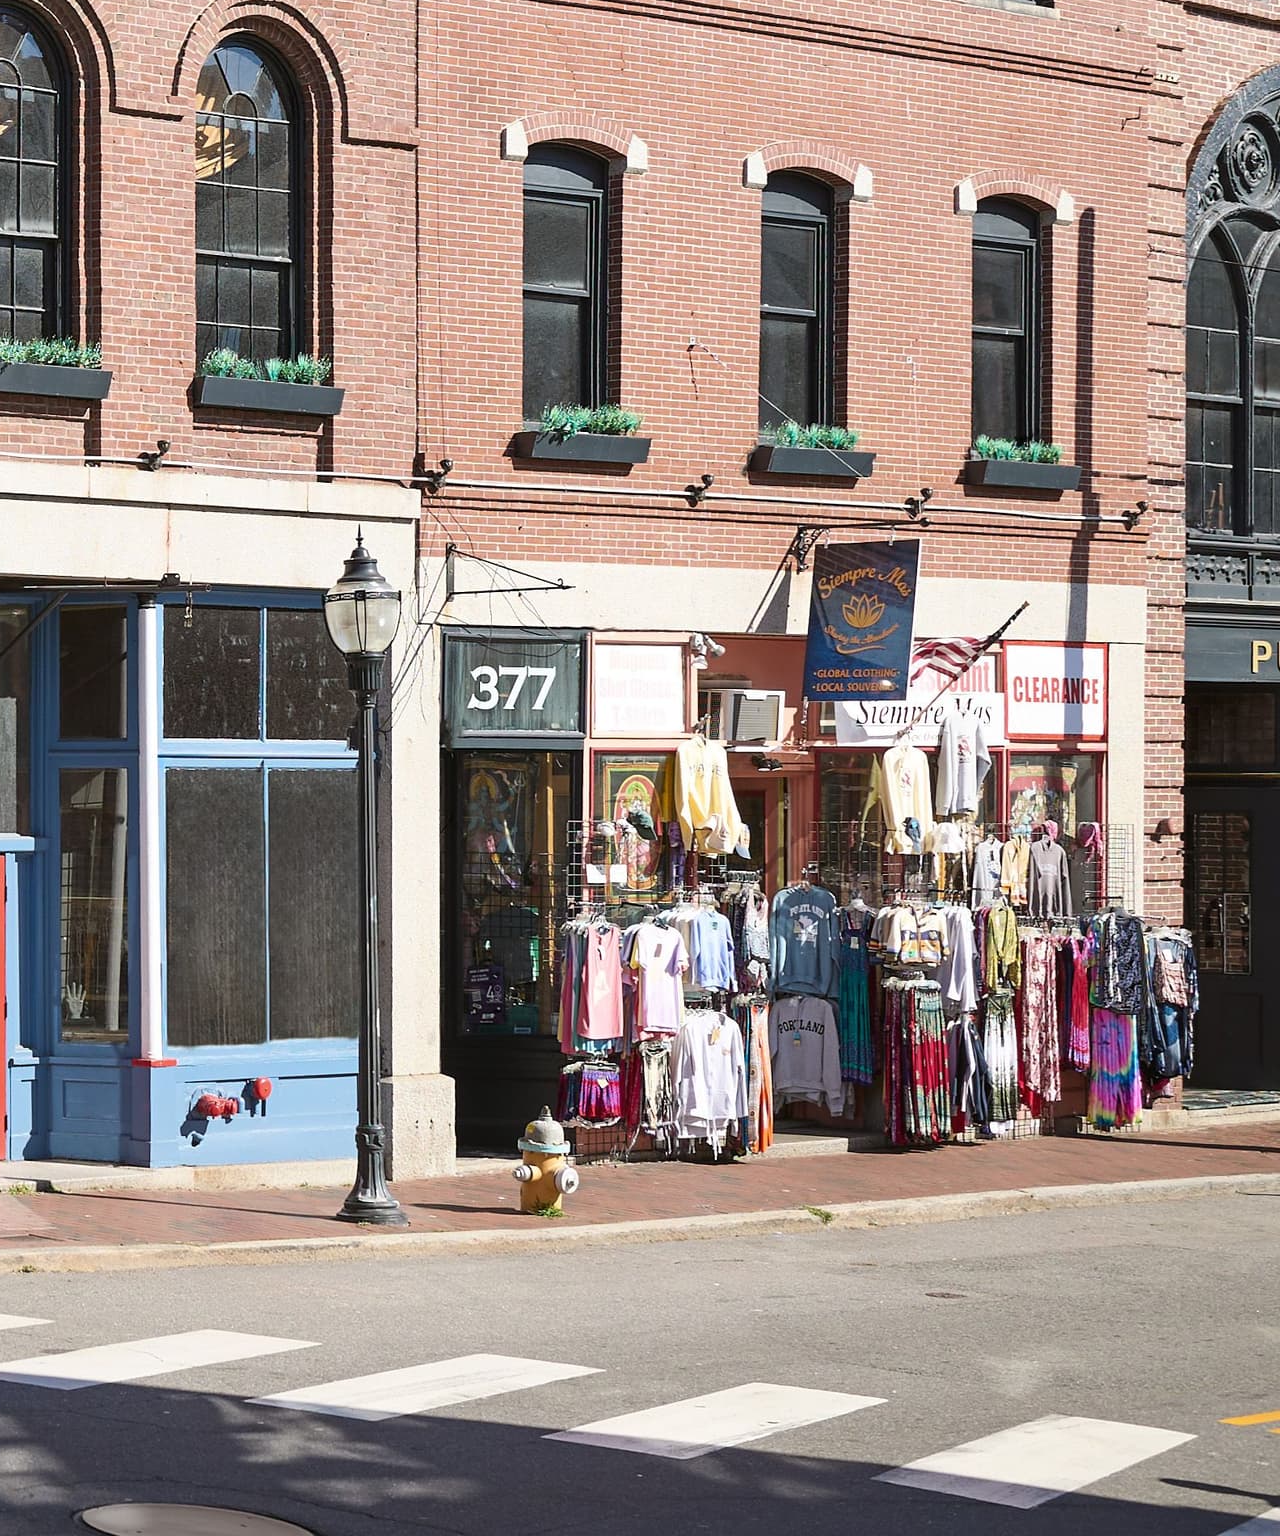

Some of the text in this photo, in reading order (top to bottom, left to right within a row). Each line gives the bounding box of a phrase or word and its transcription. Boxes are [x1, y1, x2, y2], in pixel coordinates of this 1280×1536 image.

[816, 566, 913, 600] Siempre Mas
[1251, 639, 1280, 674] P
[467, 664, 557, 710] 377
[817, 667, 898, 679] GLOBAL CLOTHING
[815, 682, 845, 693] LOCAL
[1013, 675, 1099, 705] CLEARANCE
[856, 700, 944, 727] Siempre
[777, 1018, 825, 1037] PORLAND
